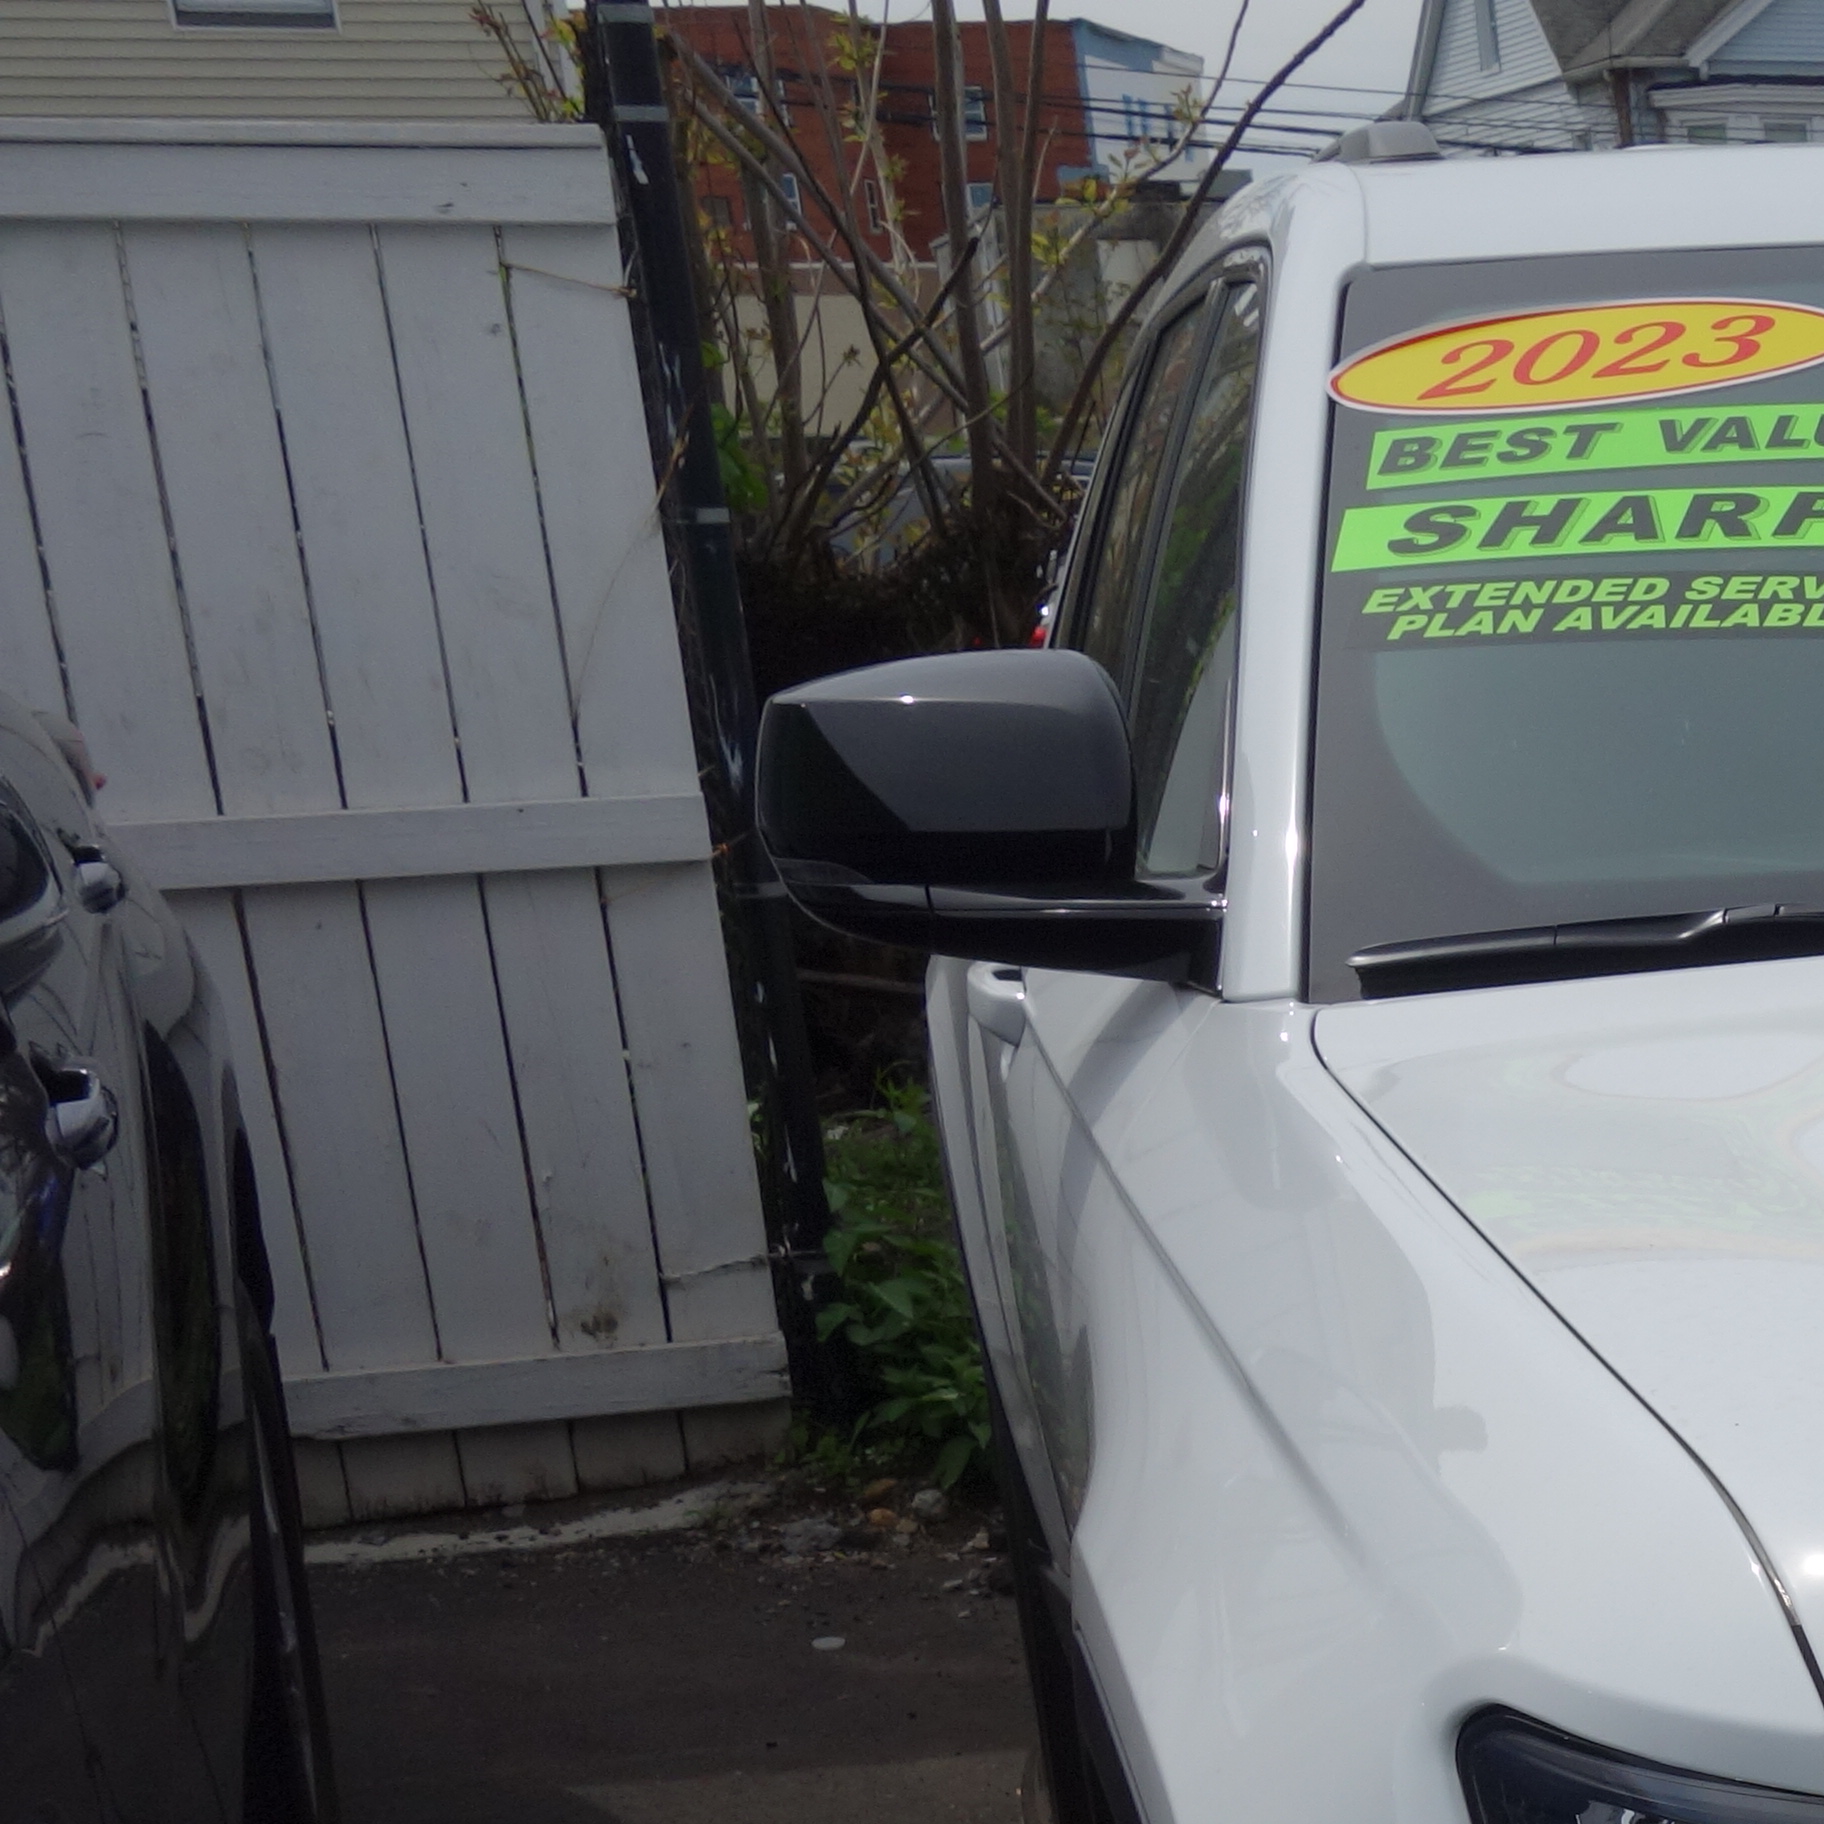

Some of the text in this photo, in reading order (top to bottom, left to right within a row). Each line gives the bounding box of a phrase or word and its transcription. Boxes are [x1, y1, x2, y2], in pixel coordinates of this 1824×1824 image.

[1417, 315, 1775, 400] 2023
[1377, 421, 1621, 476] BEST
[1362, 577, 1670, 614] EXTENDED
[1387, 606, 1546, 640] PLAN
